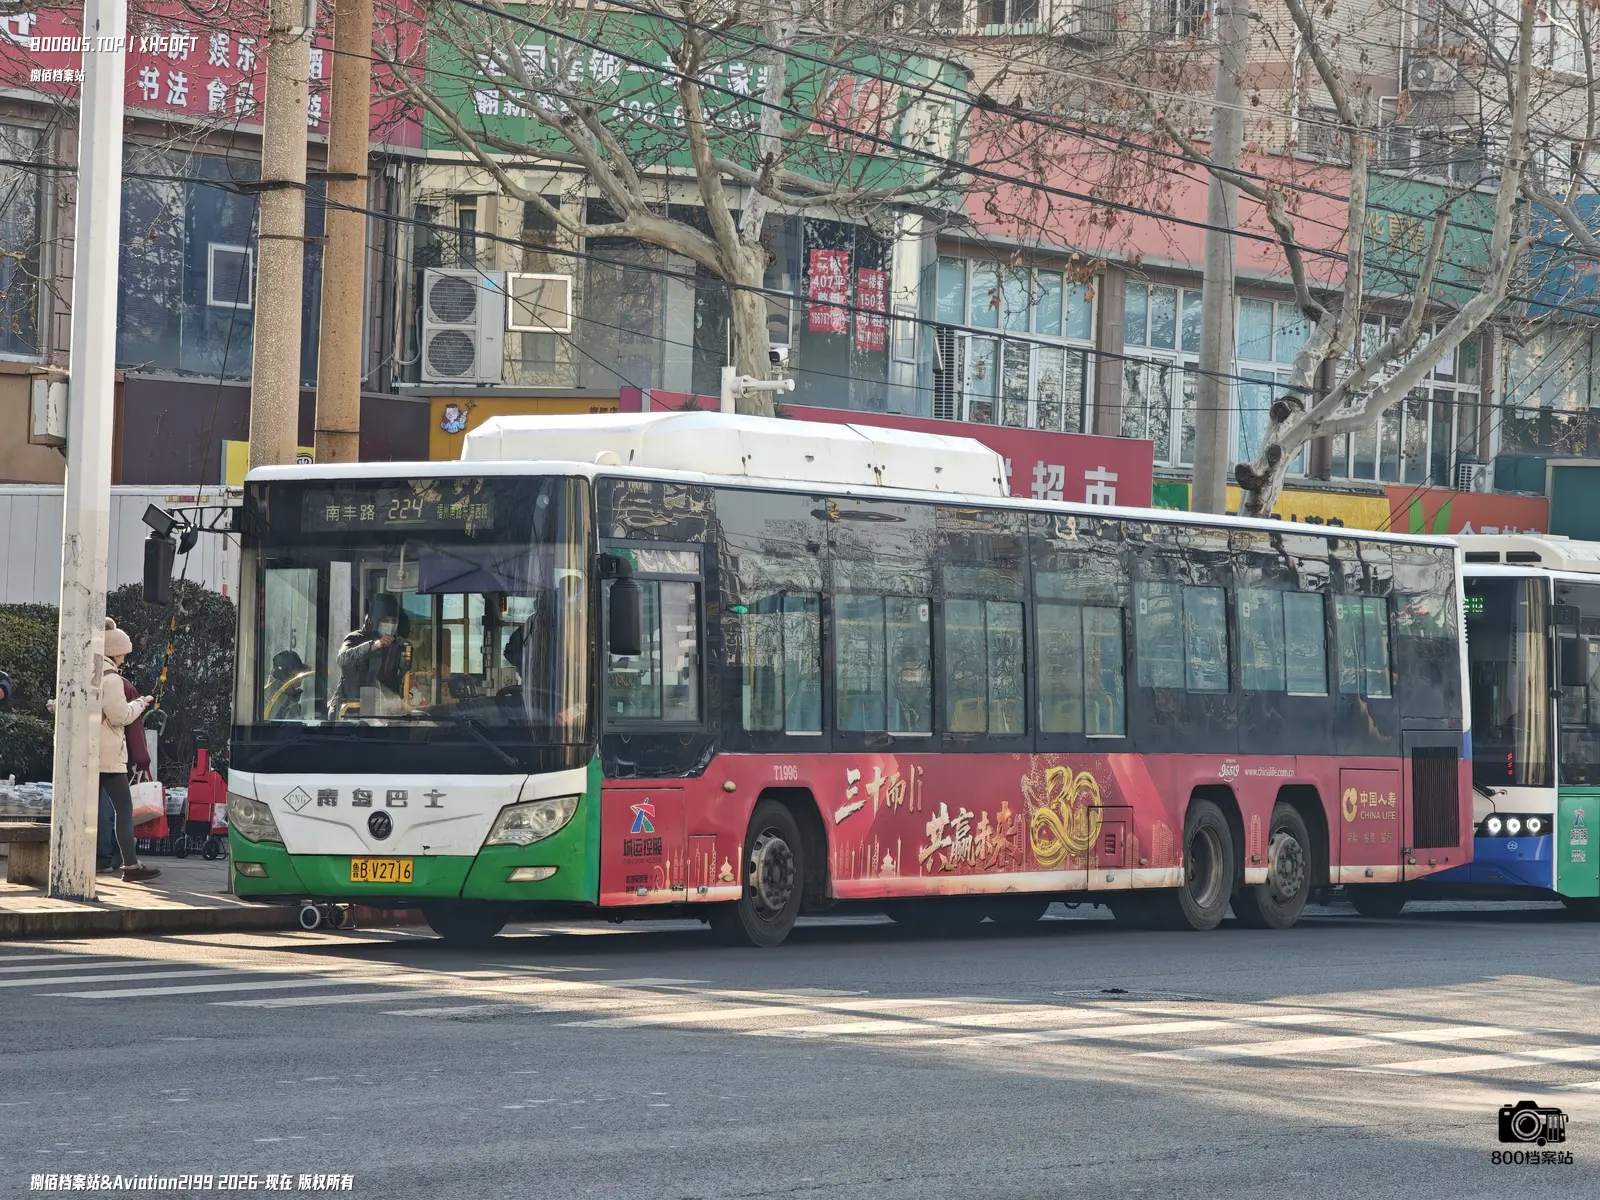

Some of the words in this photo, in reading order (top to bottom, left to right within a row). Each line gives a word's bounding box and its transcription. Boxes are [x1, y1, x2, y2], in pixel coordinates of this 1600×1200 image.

[138, 65, 189, 107] 书法
[206, 76, 257, 116] 食品
[1006, 458, 1118, 506] 超市
[325, 504, 376, 522] 南丰路
[388, 499, 425, 519] 224
[773, 765, 799, 781] T1996
[288, 794, 307, 804] CNG
[317, 788, 448, 808] 青岛巴士
[1360, 790, 1397, 808] 中国人寿
[1360, 810, 1381, 820] CHINA
[1382, 811, 1396, 820] LIFE
[623, 837, 662, 857] 城运控股
